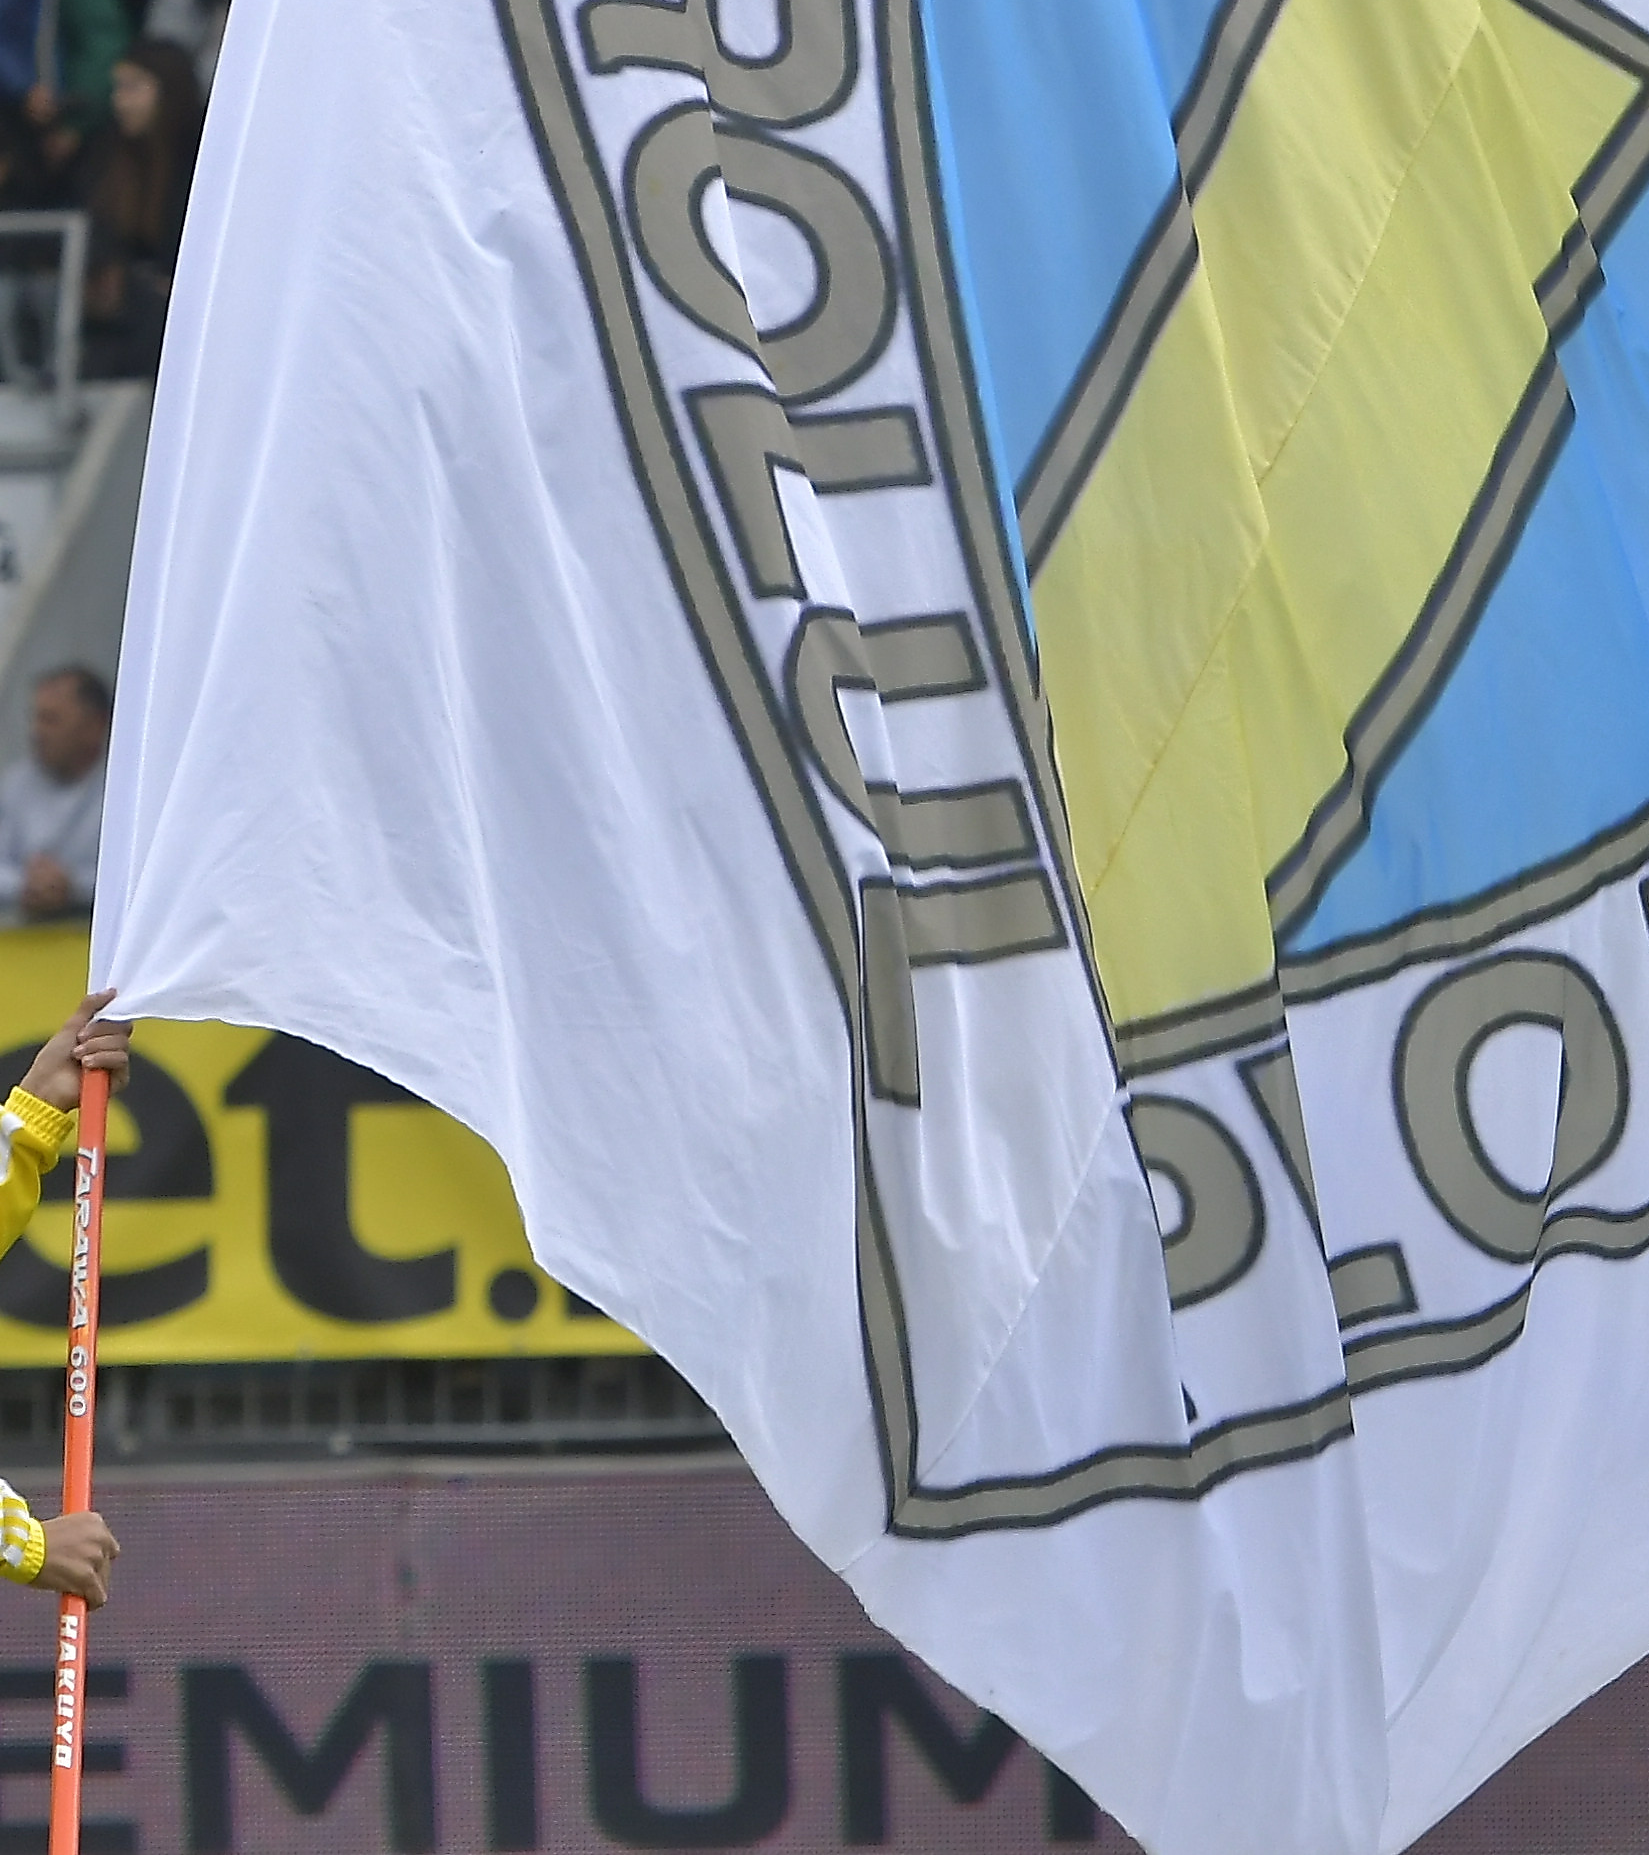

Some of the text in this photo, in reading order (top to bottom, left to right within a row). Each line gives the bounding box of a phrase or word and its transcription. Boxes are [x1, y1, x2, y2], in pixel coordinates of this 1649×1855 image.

[68, 1147, 98, 1419] TARAWA 600
[54, 1613, 79, 1771] HAKUYO
